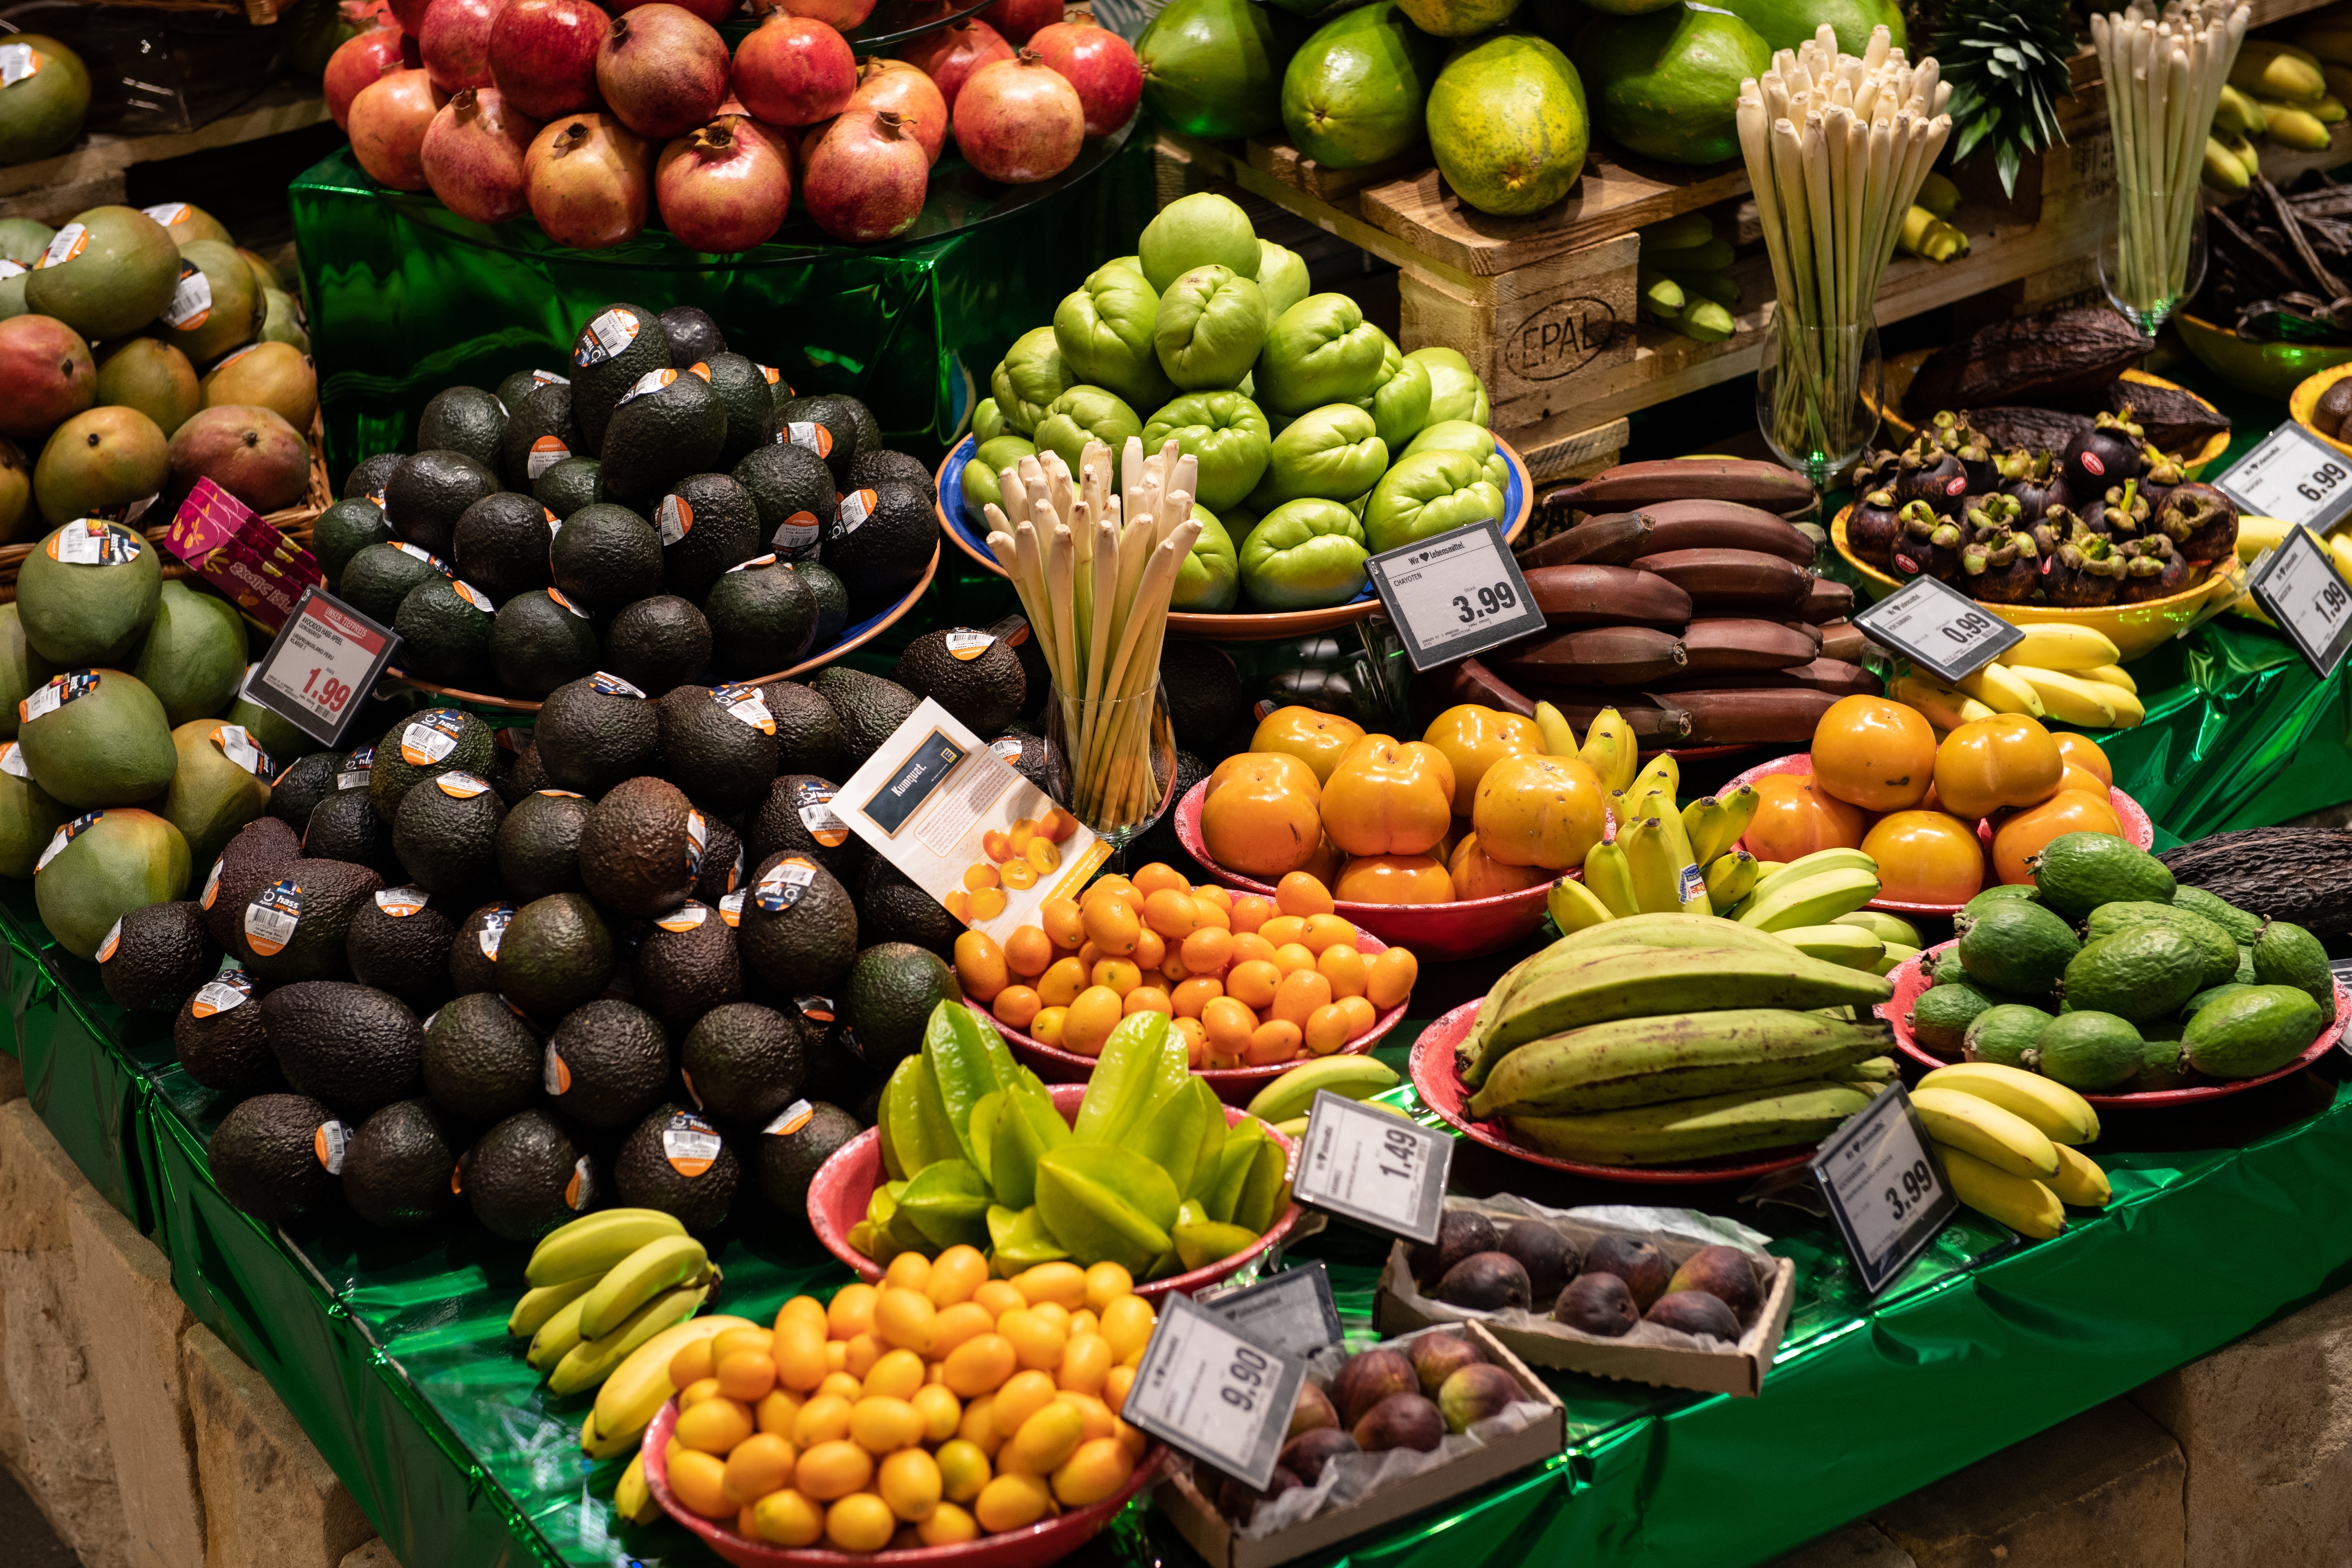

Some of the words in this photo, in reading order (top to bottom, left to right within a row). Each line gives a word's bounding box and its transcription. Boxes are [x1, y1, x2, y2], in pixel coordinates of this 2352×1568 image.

[582, 335, 595, 352] hass
[587, 328, 599, 346] avocado
[1521, 311, 1599, 369] EPAL
[597, 345, 607, 356] Apeel
[817, 430, 827, 453] genussreif
[2297, 462, 2347, 501] 6.99
[679, 503, 689, 526] genussreif
[110, 533, 120, 551] kent
[1408, 557, 1420, 565] Wir
[1429, 541, 1466, 559] Lebensmittel.
[1393, 573, 1422, 587] CHAYOTEN
[1453, 581, 1516, 623] 3.99
[2315, 580, 2347, 624] 1.99
[299, 623, 322, 639] GENUSSREIF
[302, 616, 323, 632] AVOCADOS
[322, 627, 332, 638] HASS
[330, 634, 343, 645] APEEL
[325, 606, 342, 622] UNSER
[342, 617, 368, 637] TIEFPREIS
[1942, 613, 1991, 644] 0.99
[290, 637, 304, 649] KLASSE
[293, 632, 324, 654] URSPRUNGSLAND
[323, 651, 334, 661] PERU
[958, 648, 981, 656] genussreif
[302, 668, 350, 712] 1.99
[594, 677, 615, 687] hass
[435, 724, 459, 739] avocado
[438, 719, 460, 732] hass
[891, 763, 927, 797] Kumquat.
[1074, 859, 1090, 877] schönsten
[1089, 846, 1102, 860] Exoten.
[1690, 883, 1706, 894] Dole
[277, 895, 299, 909] hass
[253, 940, 278, 950] genussreif
[1379, 1129, 1417, 1179] 1.49
[1885, 1159, 1933, 1220] 3.99
[1220, 1346, 1267, 1413] 9.90
